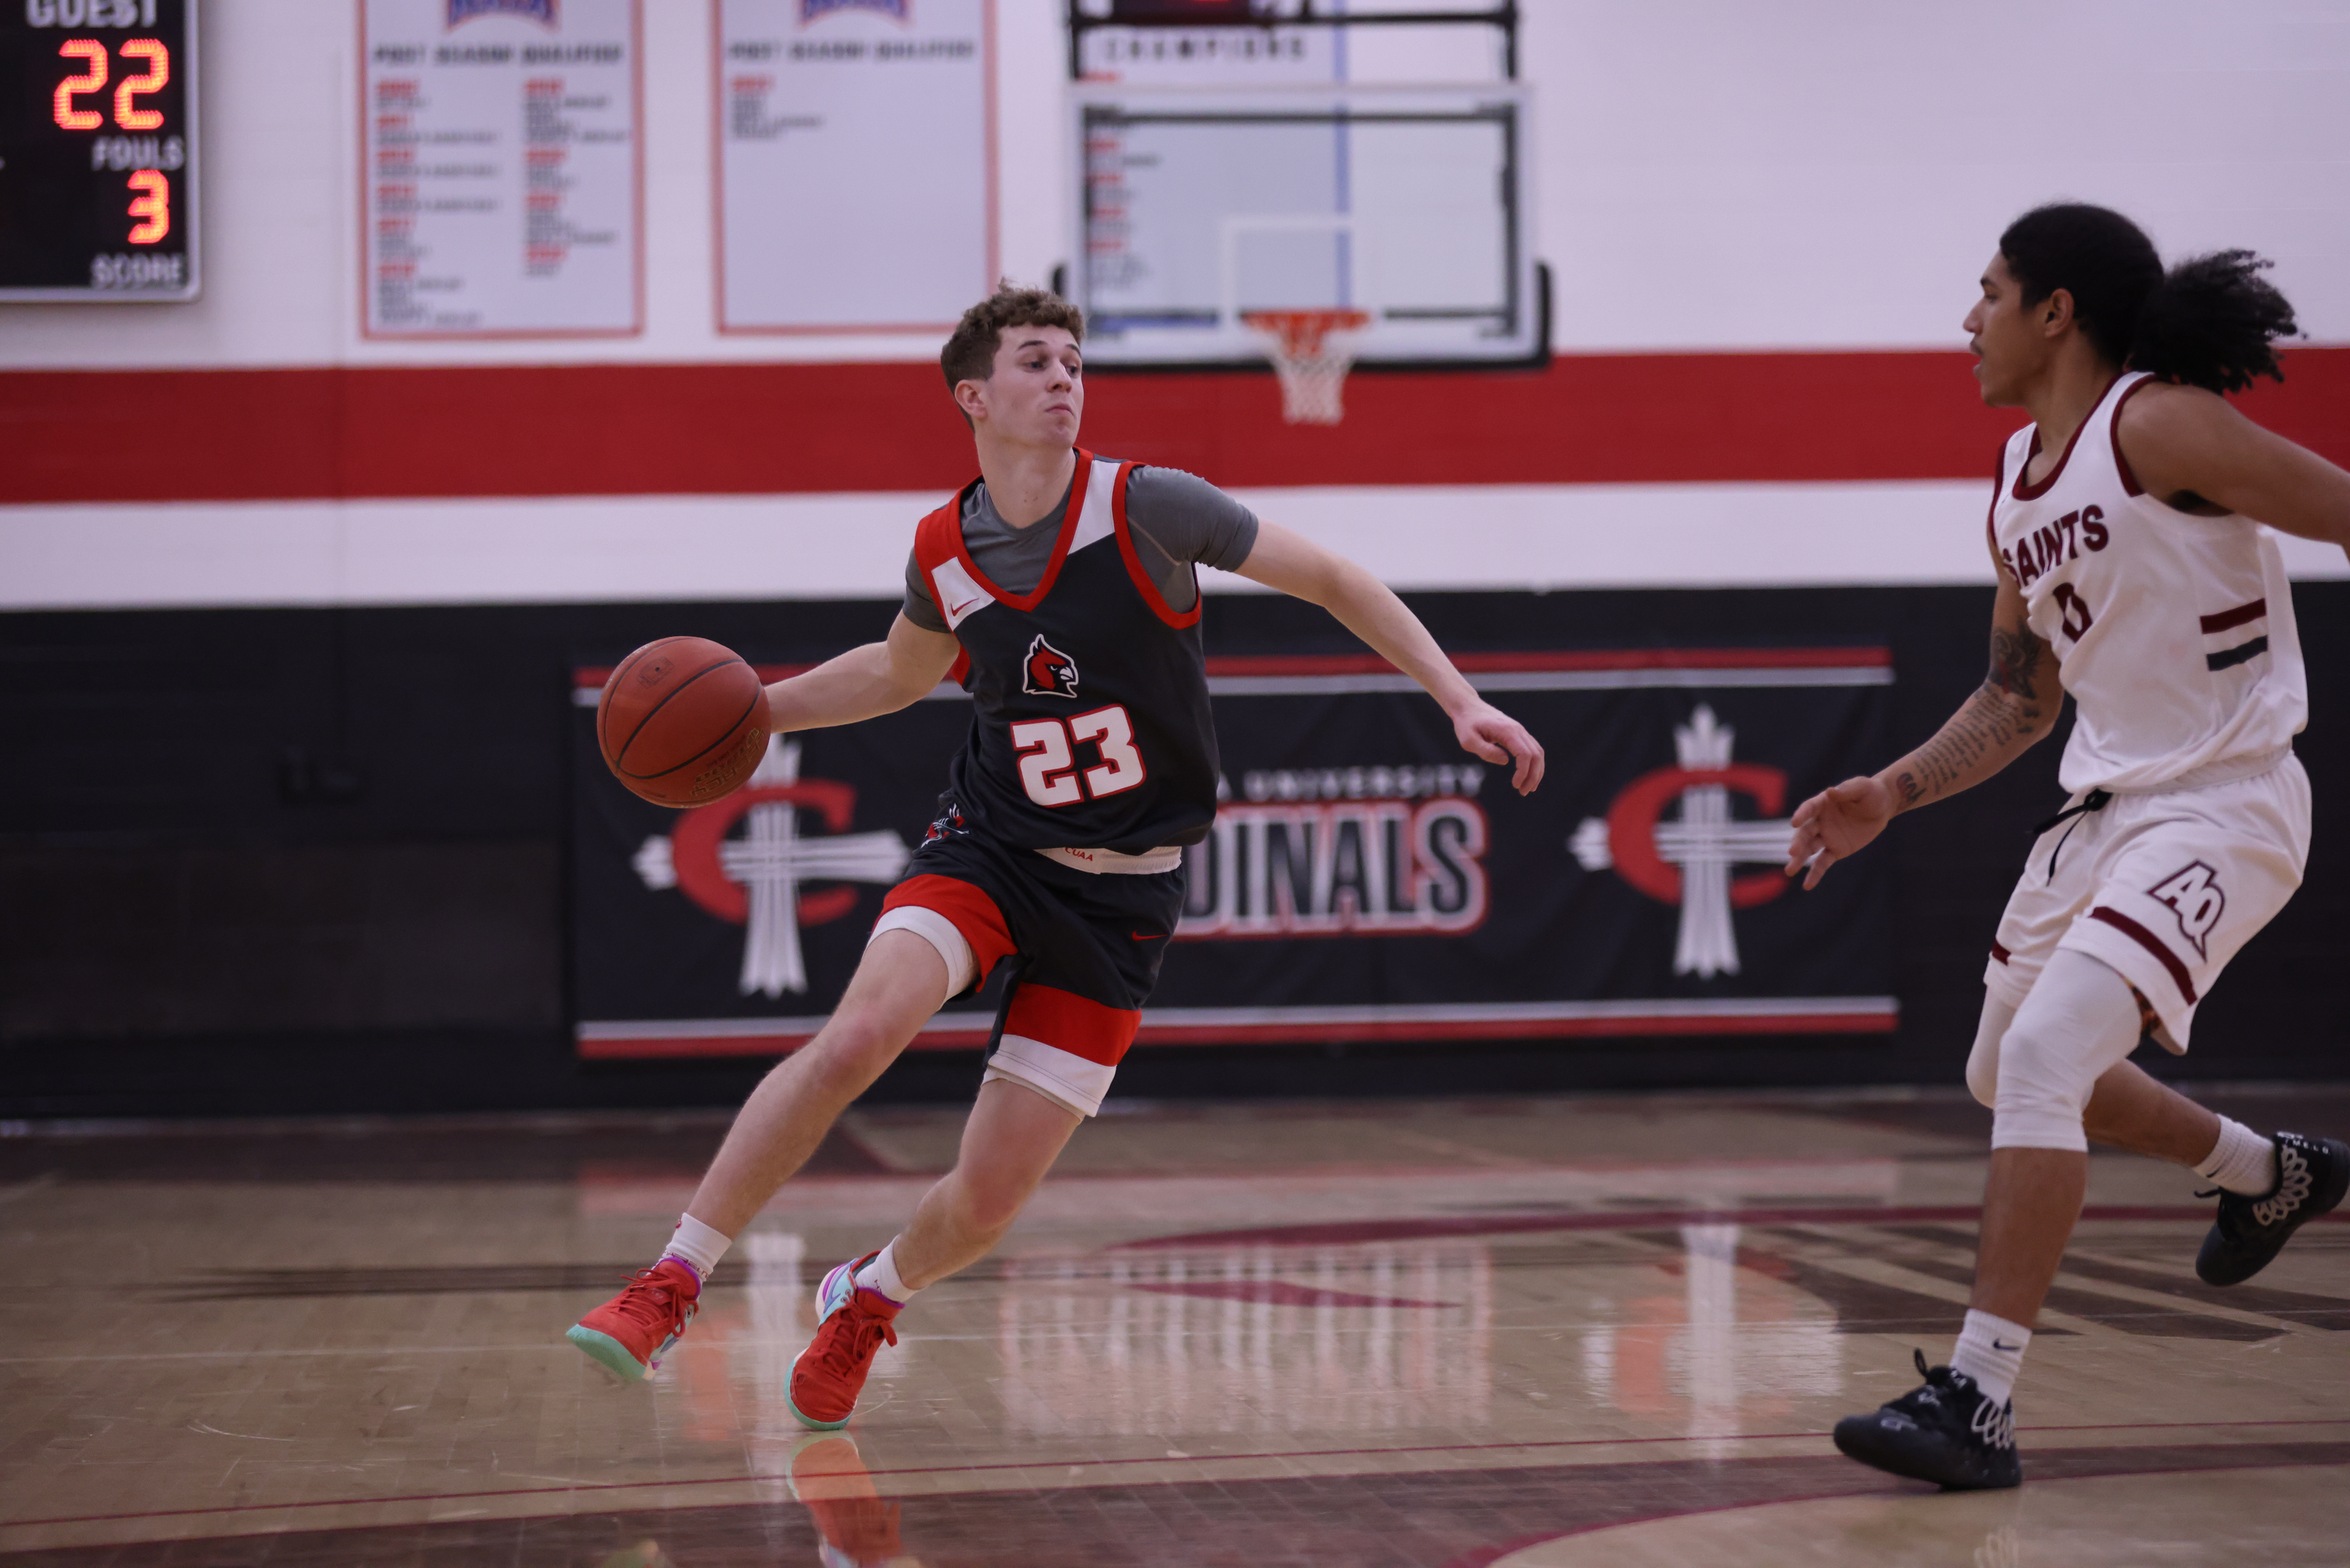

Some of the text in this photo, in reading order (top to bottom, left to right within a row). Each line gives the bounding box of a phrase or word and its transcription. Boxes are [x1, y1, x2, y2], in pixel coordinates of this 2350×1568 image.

[26, 0, 157, 28] GUEST
[54, 38, 169, 130] 22
[91, 135, 185, 170] FOULS
[127, 169, 170, 244] 3
[91, 254, 184, 289] SCORE
[2052, 582, 2094, 643] 0
[1009, 704, 1148, 809] 23
[1243, 764, 1485, 800] UNIVERSITY
